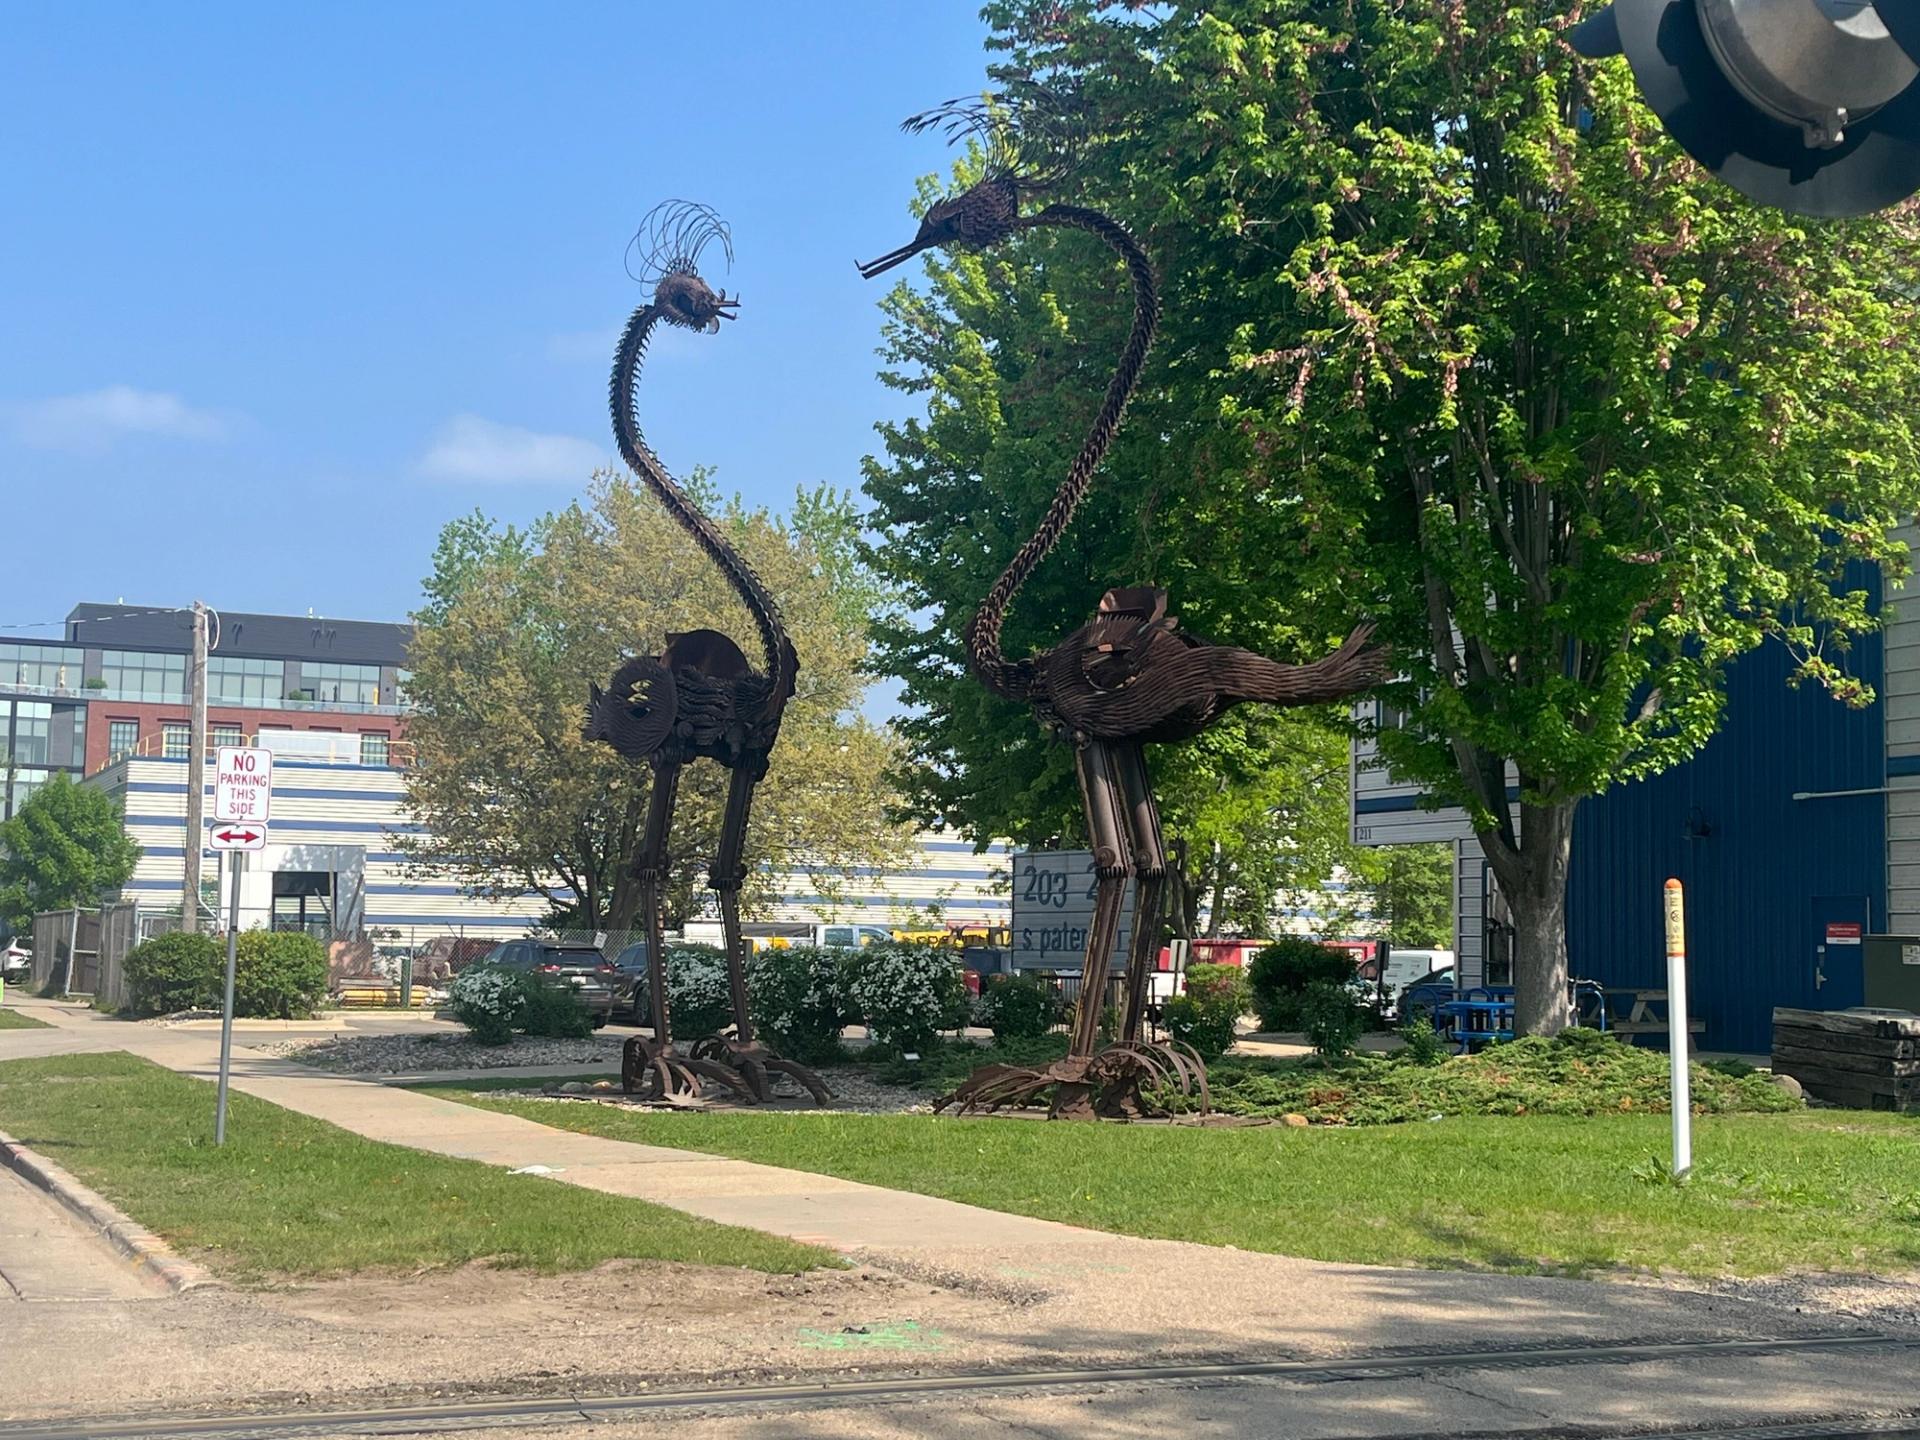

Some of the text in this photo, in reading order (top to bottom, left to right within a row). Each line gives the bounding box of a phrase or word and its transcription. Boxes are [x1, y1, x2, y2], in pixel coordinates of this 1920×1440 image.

[233, 754, 256, 772] NO
[220, 773, 267, 787] PARKING
[230, 788, 256, 800] THIS
[229, 802, 255, 815] SIDE
[1023, 864, 1068, 908] 203
